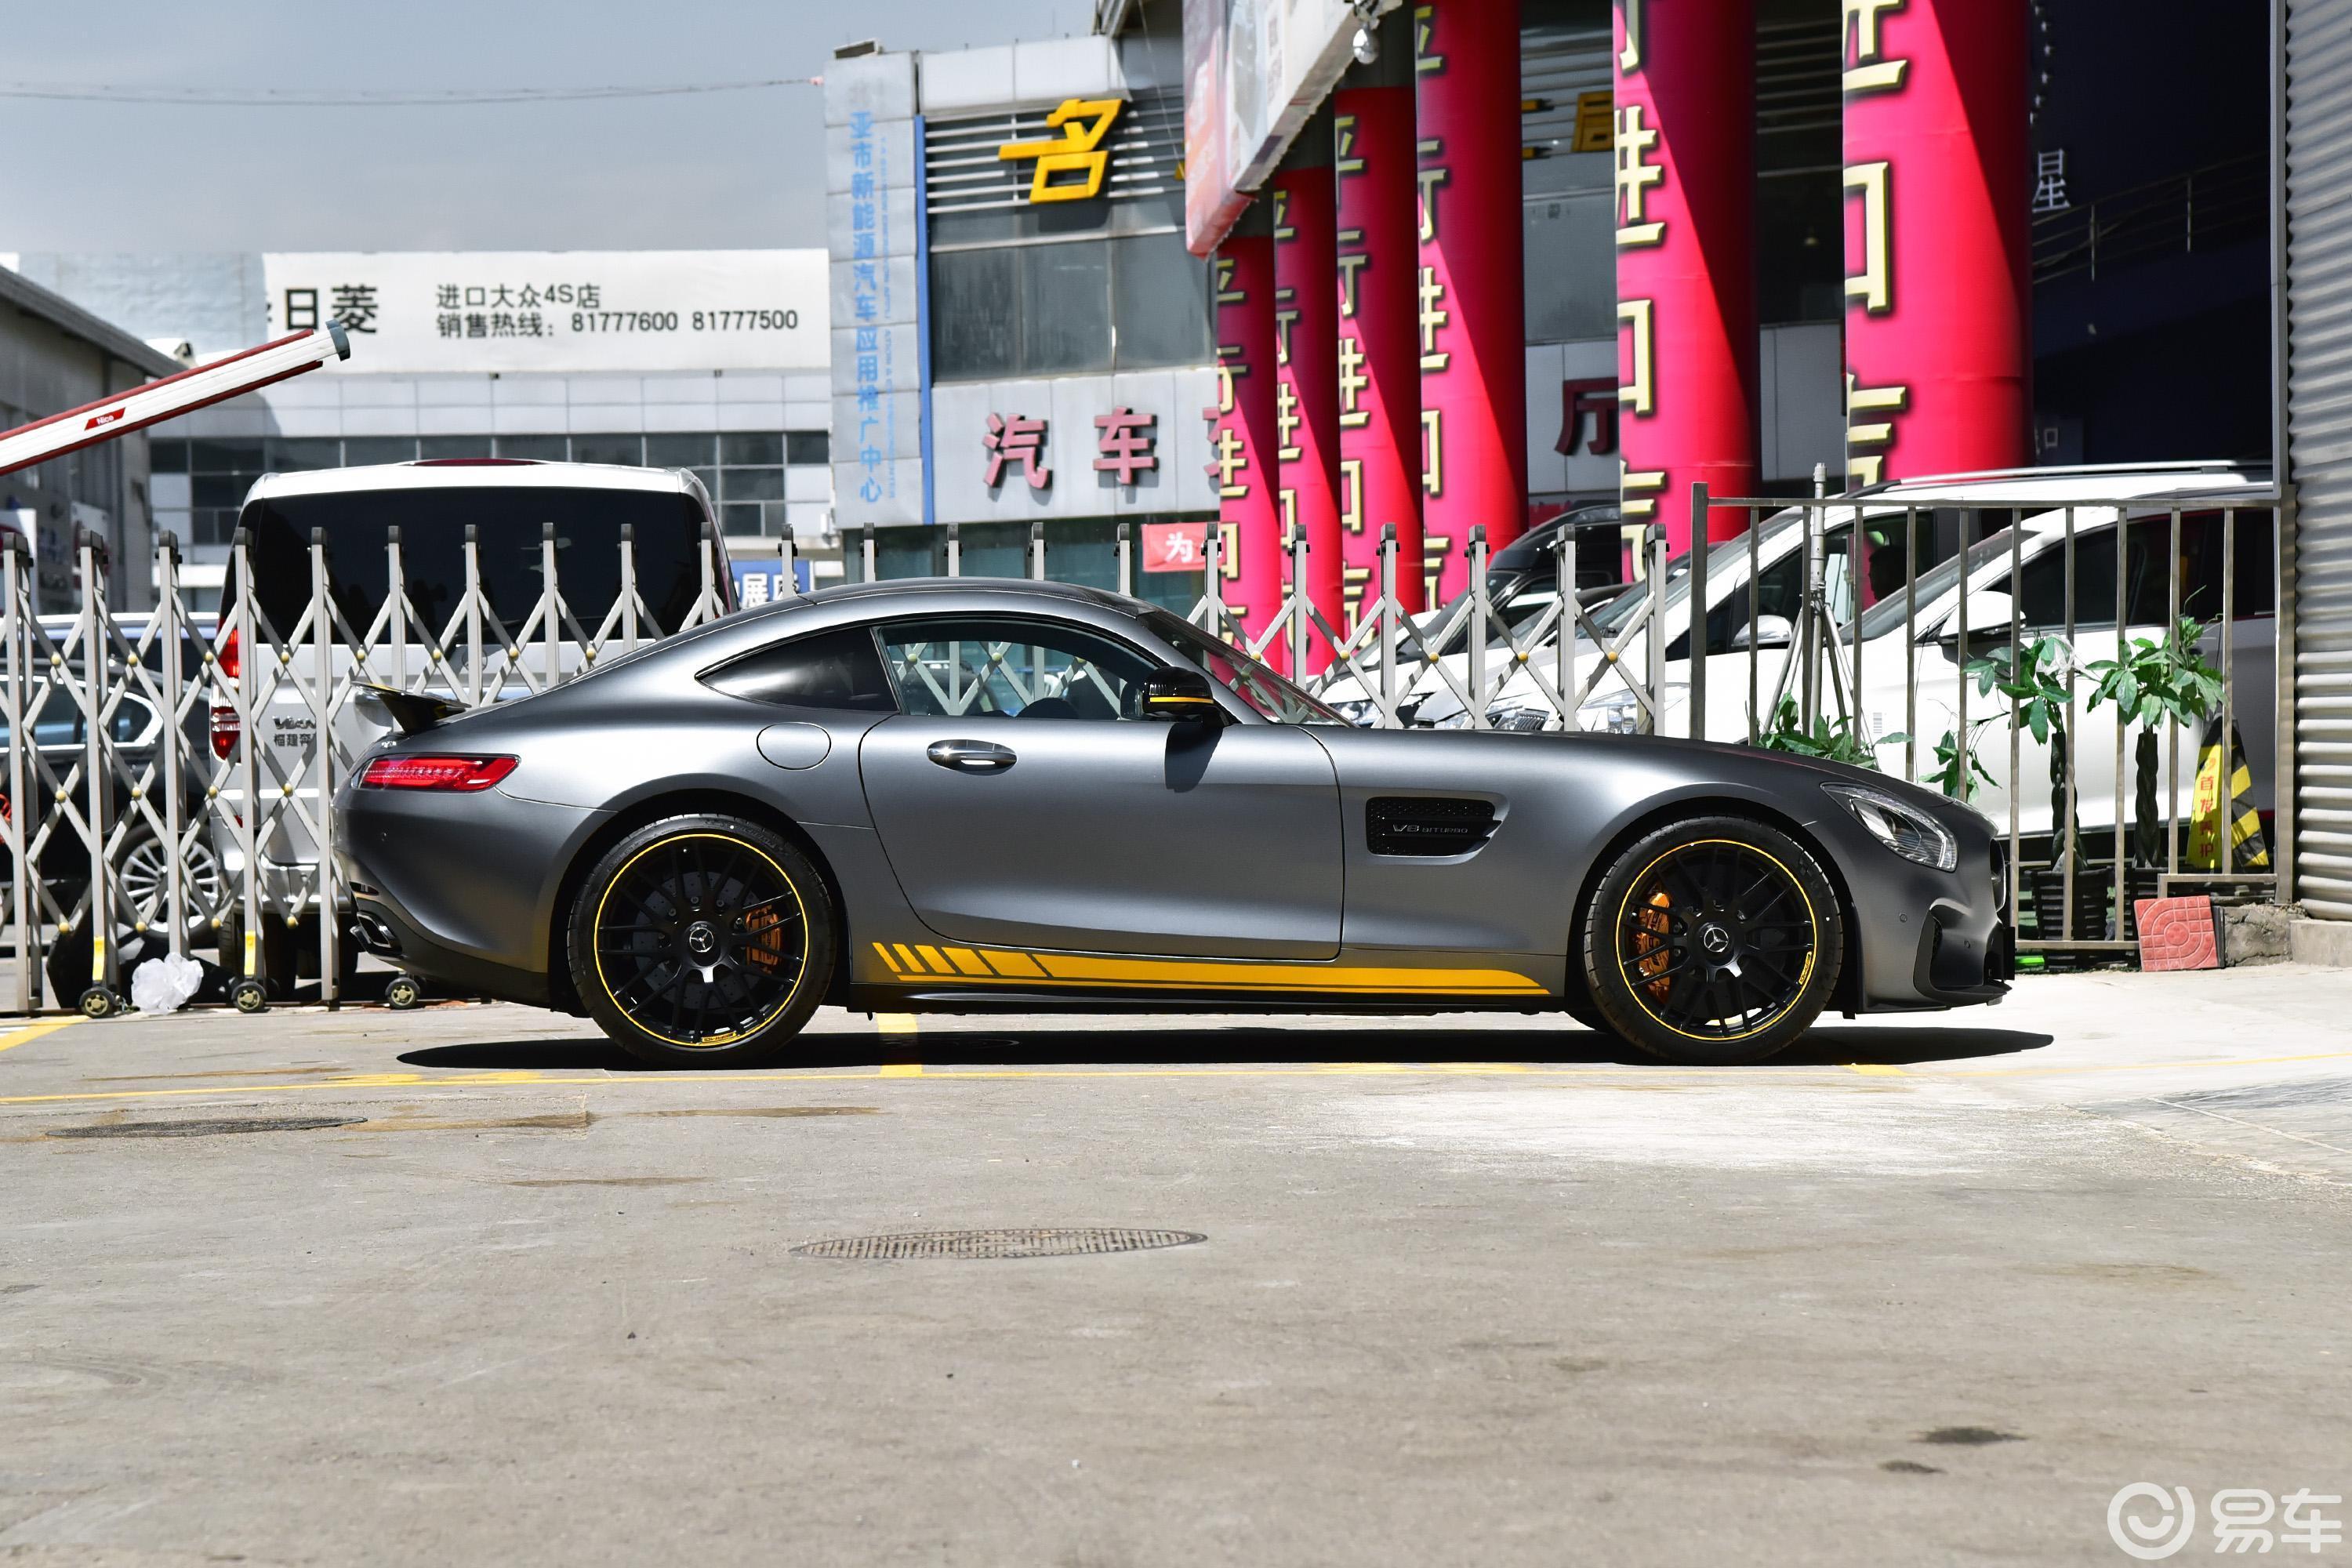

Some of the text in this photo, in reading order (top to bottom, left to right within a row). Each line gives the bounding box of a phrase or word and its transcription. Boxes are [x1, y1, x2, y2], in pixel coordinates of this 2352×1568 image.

[998, 98, 1123, 203] 名
[2032, 149, 2070, 213] 星
[267, 285, 378, 334] 日菱
[436, 283, 601, 310] 进口大众4S店
[571, 312, 679, 332] 81777600
[692, 310, 798, 330] 81777500
[96, 415, 114, 425] Nice
[1392, 824, 1420, 833] V8
